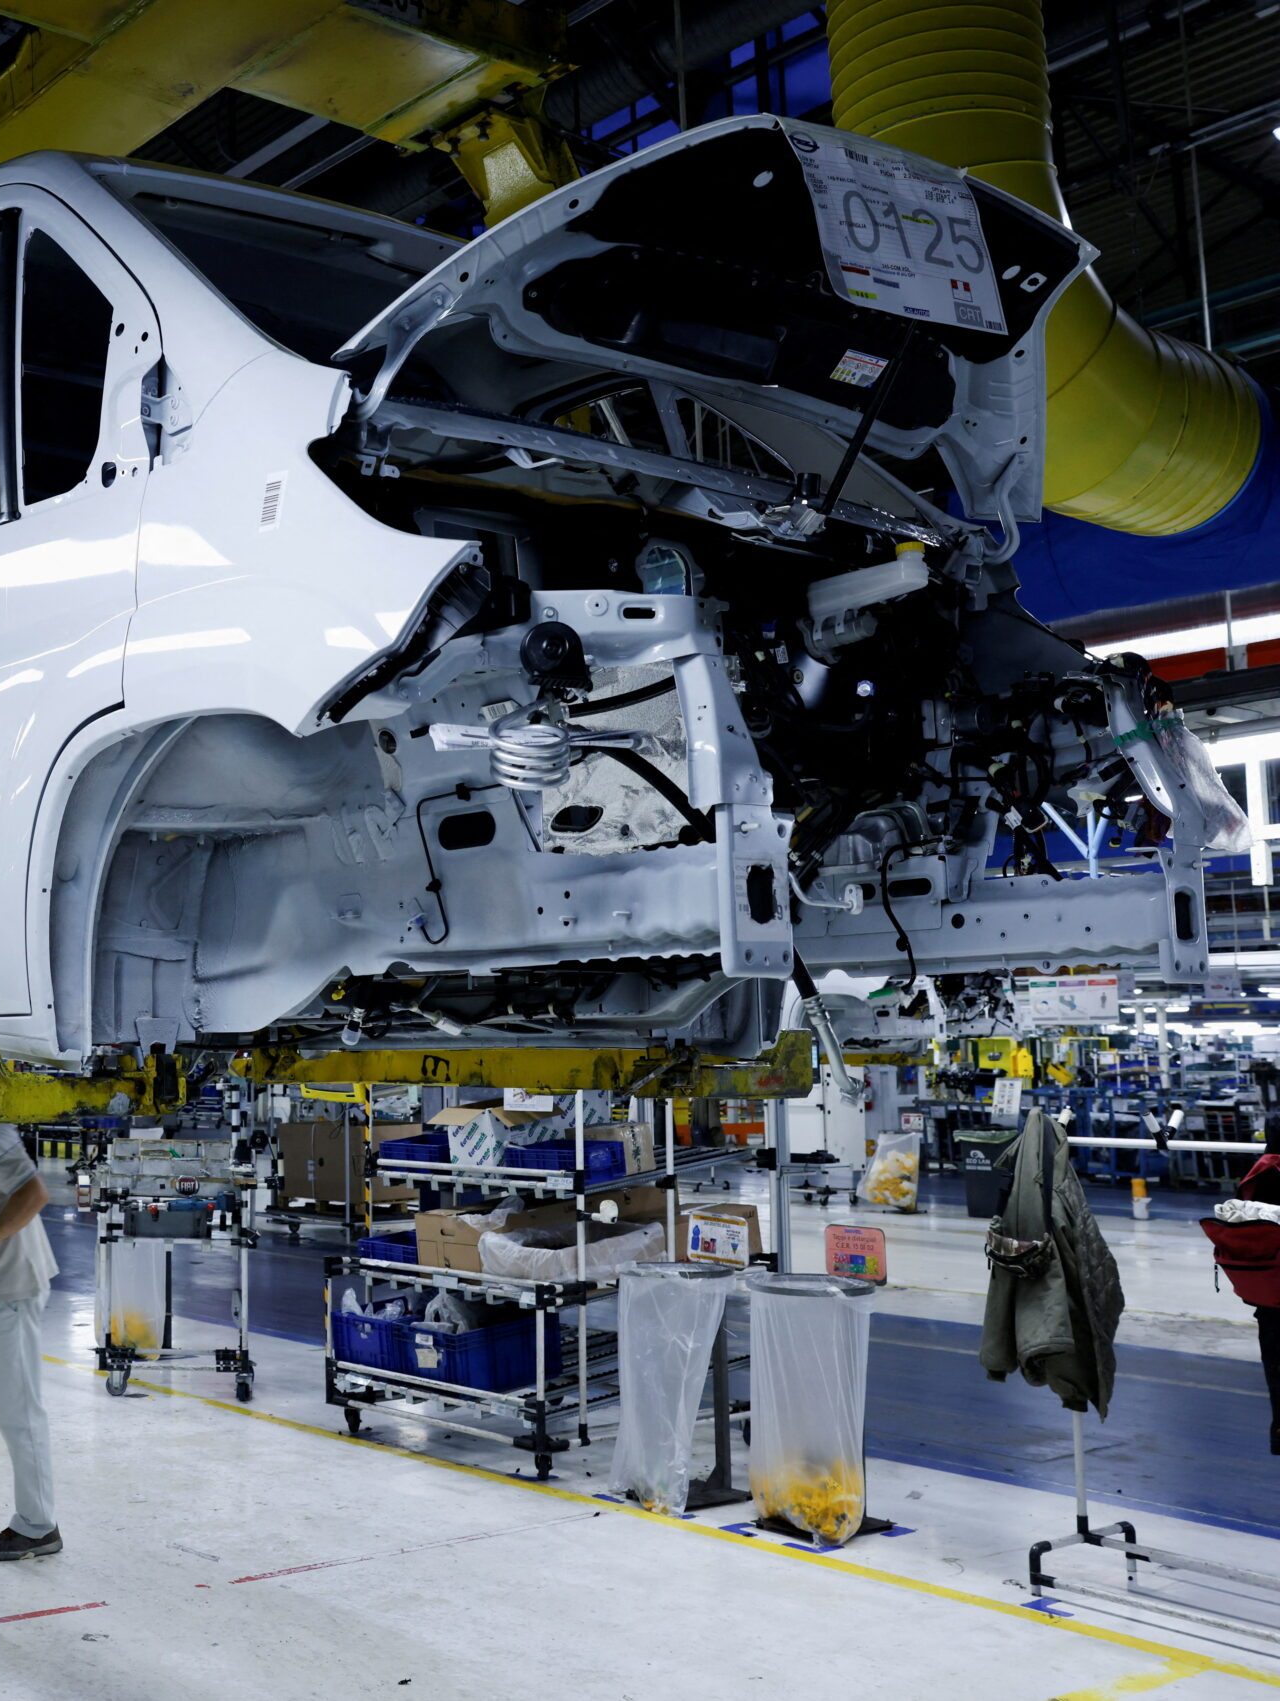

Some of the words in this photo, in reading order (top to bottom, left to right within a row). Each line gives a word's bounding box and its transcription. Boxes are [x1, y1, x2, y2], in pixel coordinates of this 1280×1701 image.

[843, 190, 984, 274] 0125
[959, 306, 982, 324] CRT
[180, 1181, 196, 1191] FIAT
